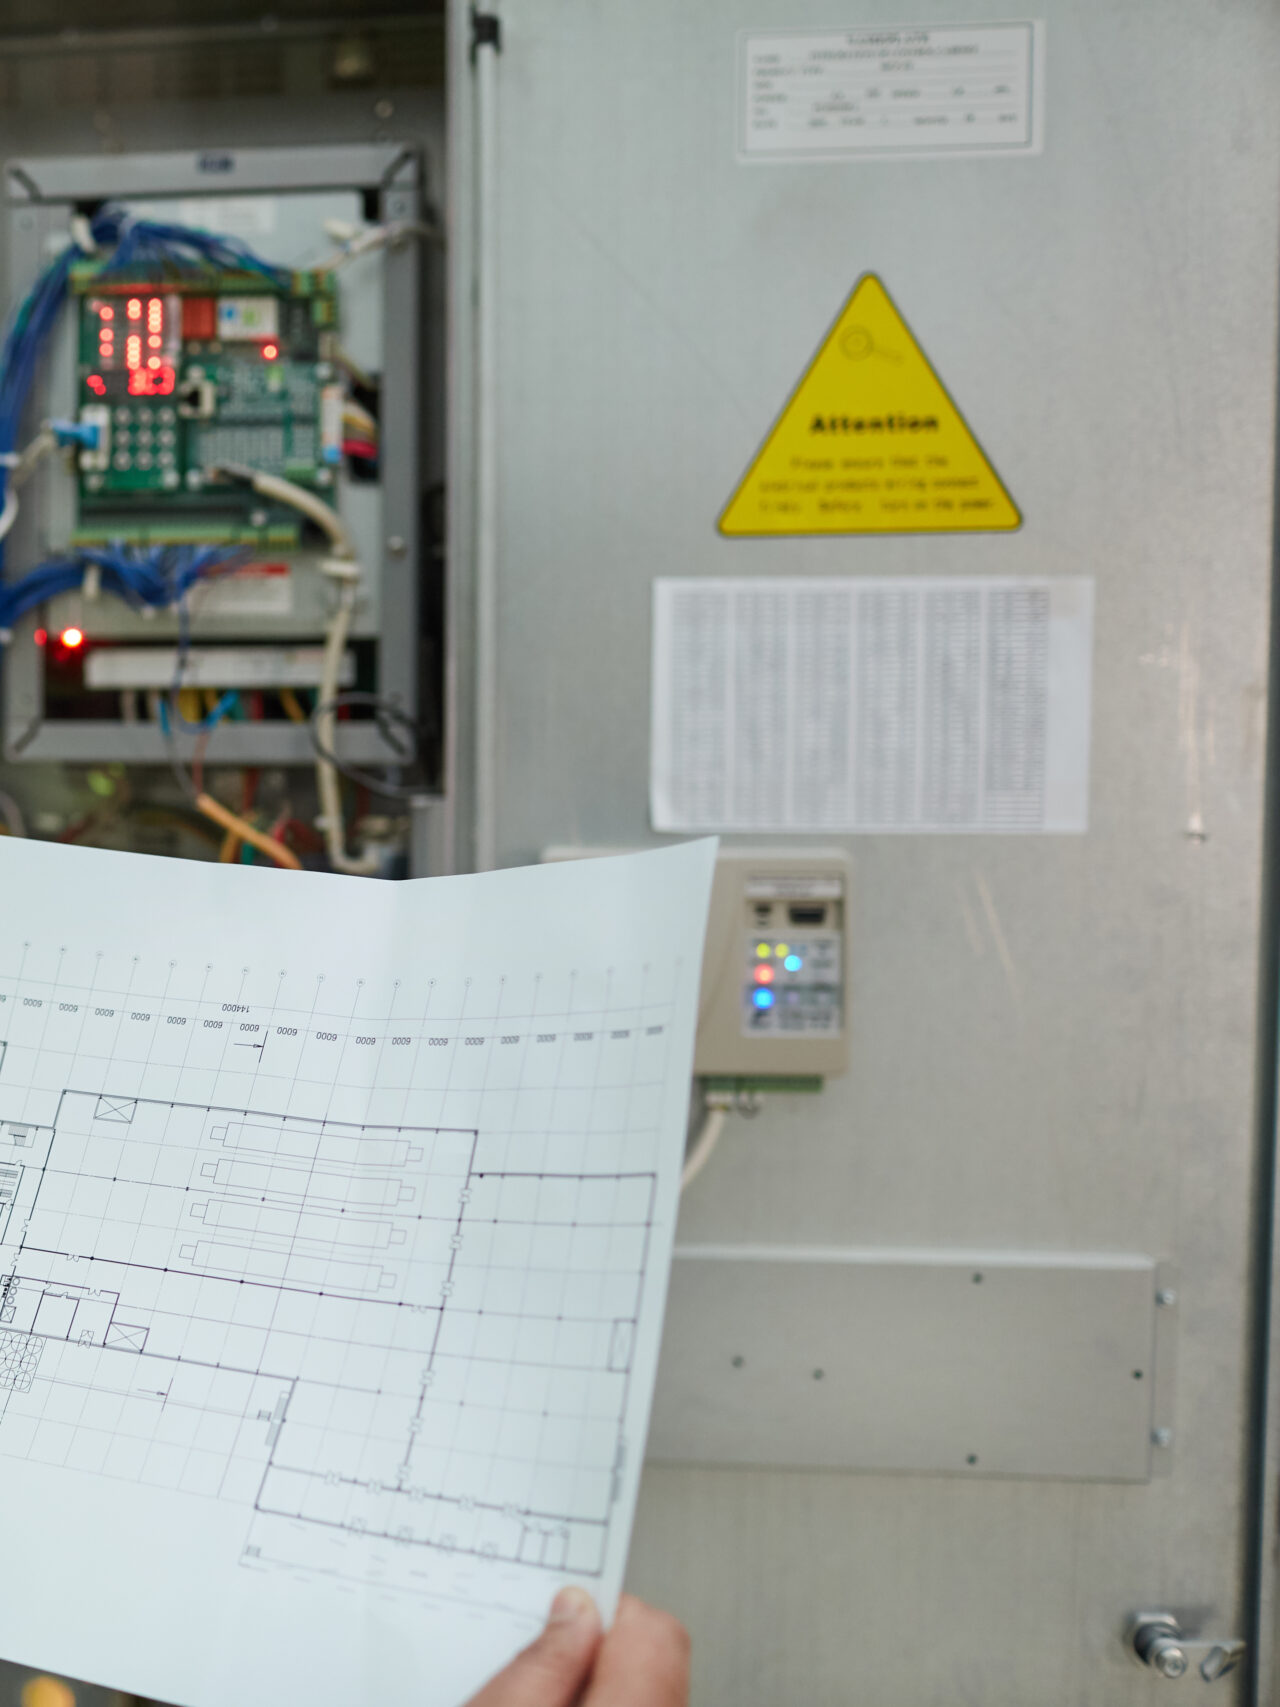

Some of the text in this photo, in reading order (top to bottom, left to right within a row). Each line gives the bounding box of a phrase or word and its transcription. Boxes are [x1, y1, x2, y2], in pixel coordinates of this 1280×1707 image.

[811, 414, 939, 435] Attention
[23, 998, 43, 1008] 6000
[59, 1003, 78, 1012] 6000
[95, 1008, 115, 1017] 6000
[222, 1003, 250, 1013] 144000
[131, 1012, 150, 1022] 6000
[167, 1016, 186, 1025] 6000
[204, 1020, 223, 1028] 6000
[240, 1023, 260, 1032] 6000
[277, 1027, 298, 1036] 6000
[316, 1031, 337, 1041] 6000
[356, 1036, 376, 1045] 6000
[392, 1037, 411, 1046] 6000
[428, 1038, 448, 1046] 6000
